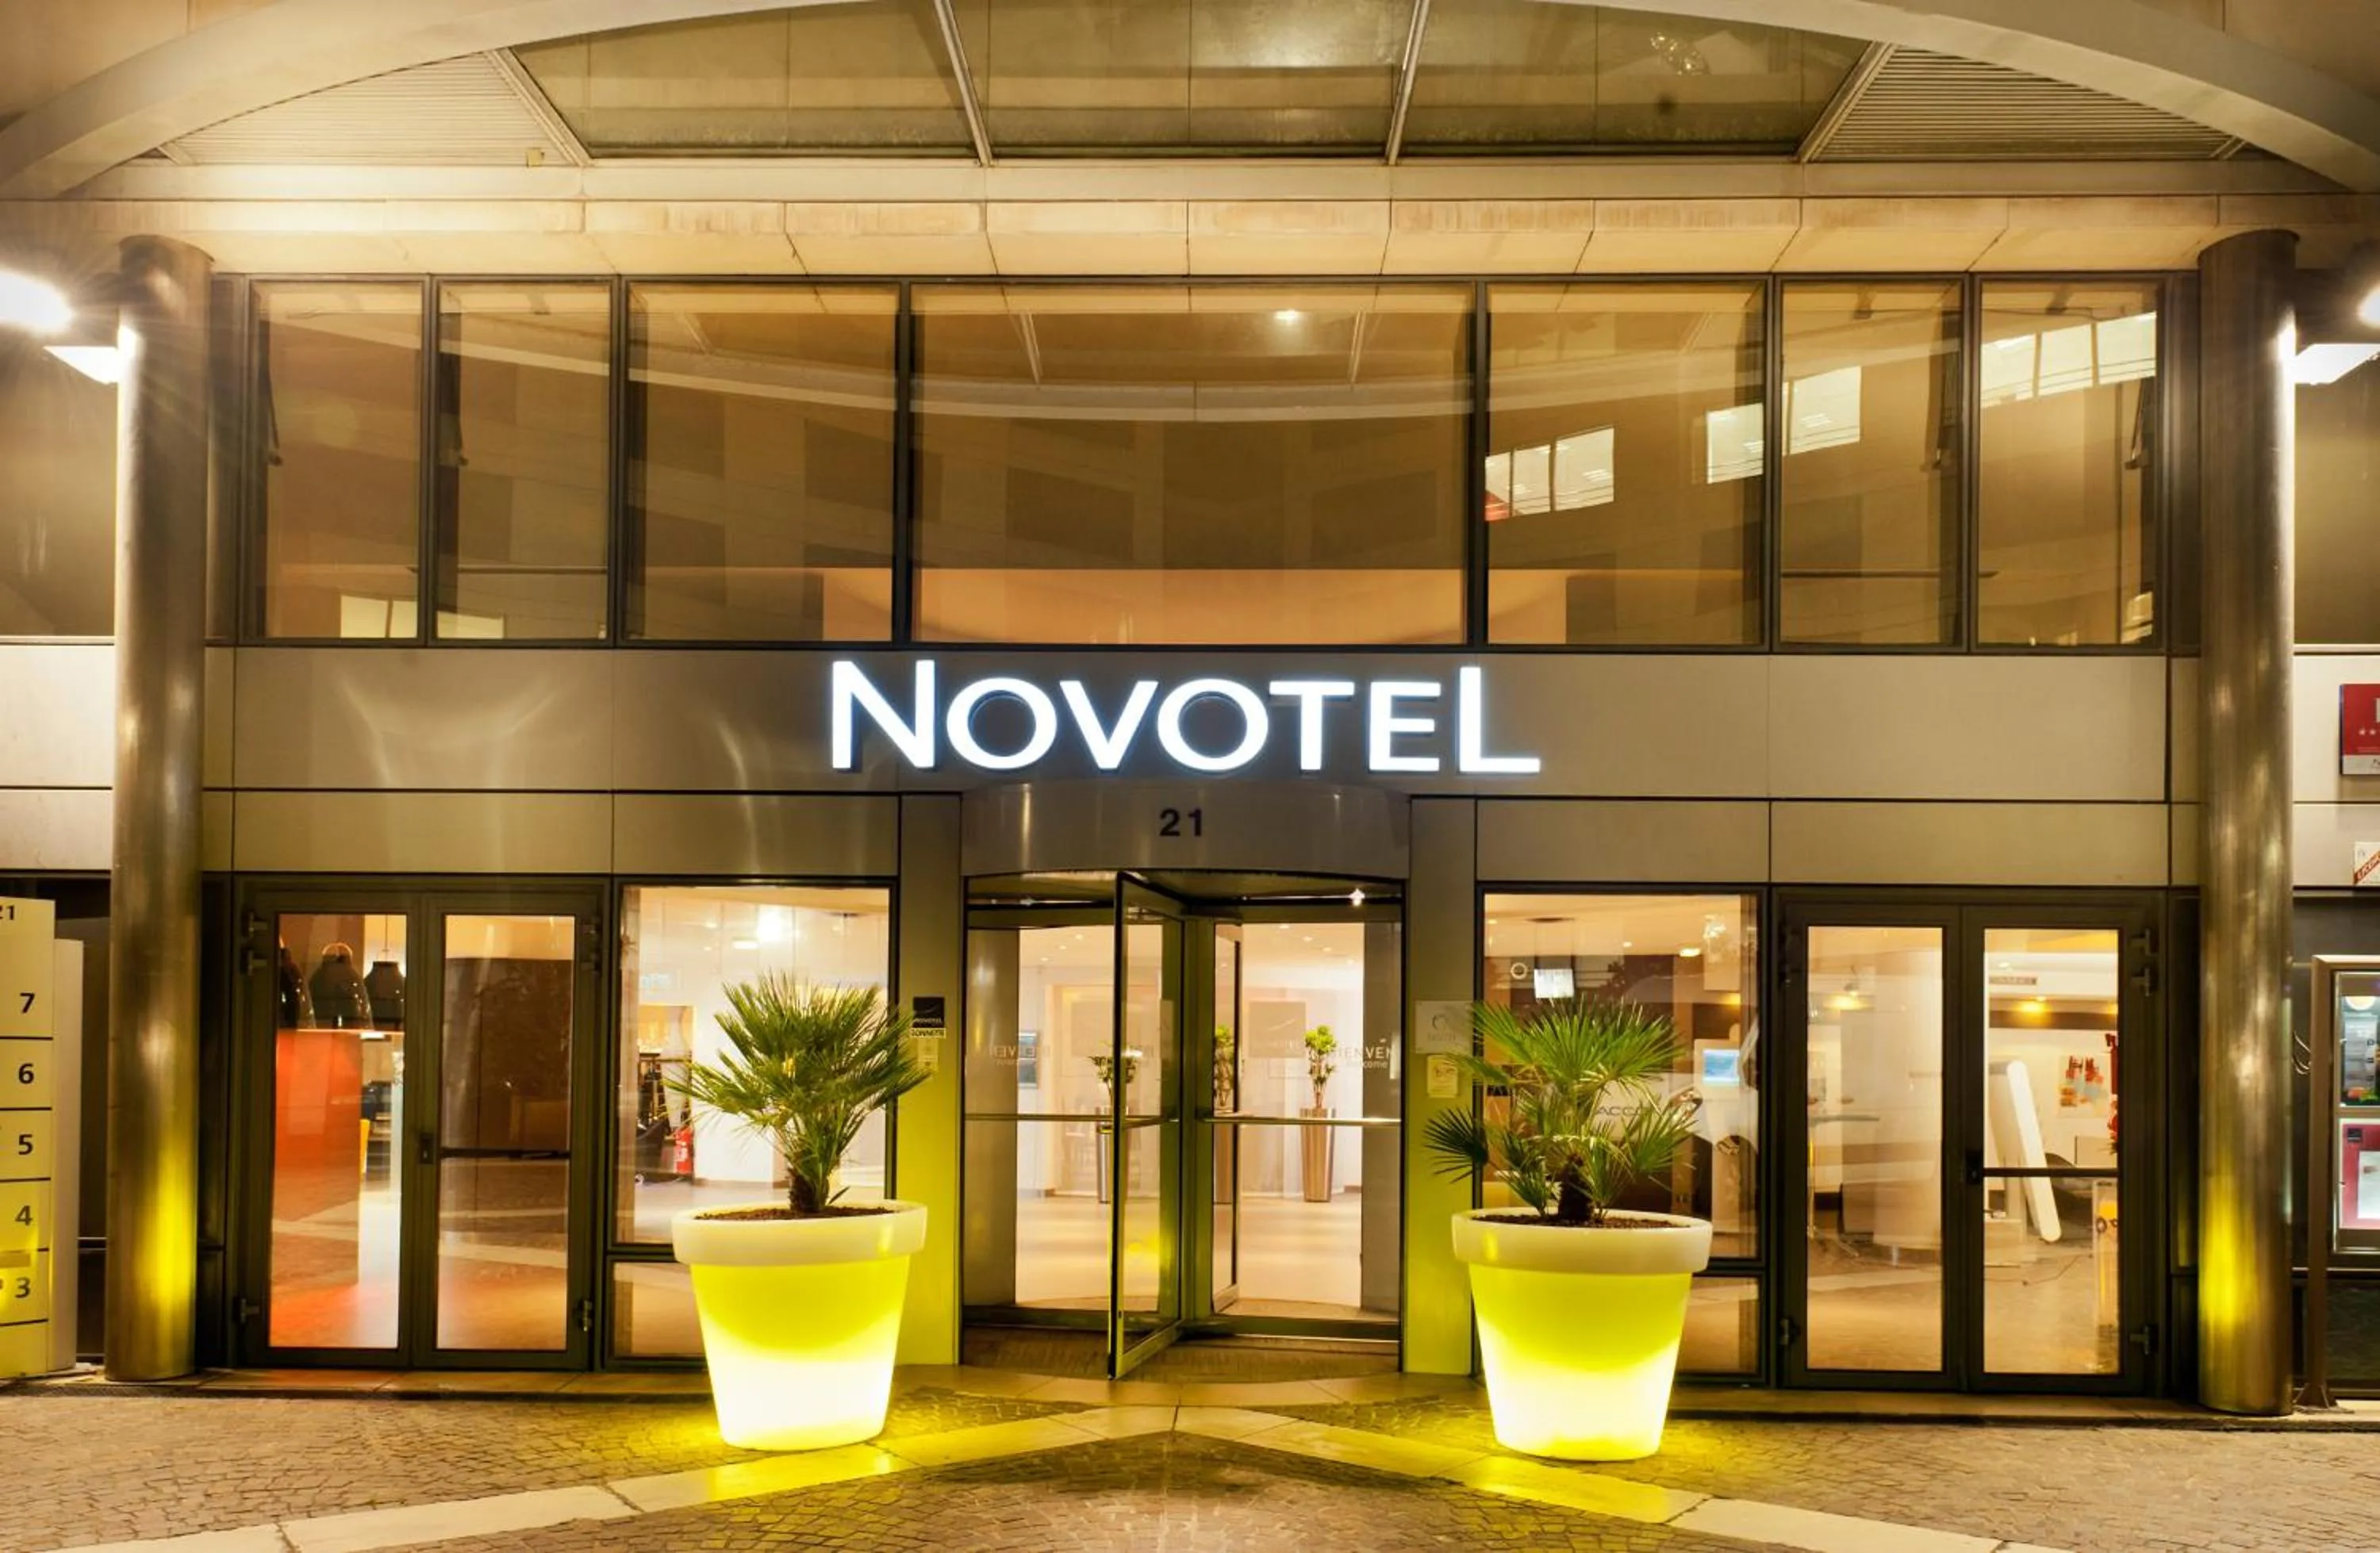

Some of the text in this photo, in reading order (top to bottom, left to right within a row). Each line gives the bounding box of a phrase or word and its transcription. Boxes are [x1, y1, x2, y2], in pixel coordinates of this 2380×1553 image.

[1160, 810, 1203, 838] 21
[20, 993, 35, 1014] 7
[17, 1064, 34, 1083] 6
[17, 1134, 33, 1155] 5
[15, 1205, 33, 1226] 4
[15, 1277, 30, 1298] 3
